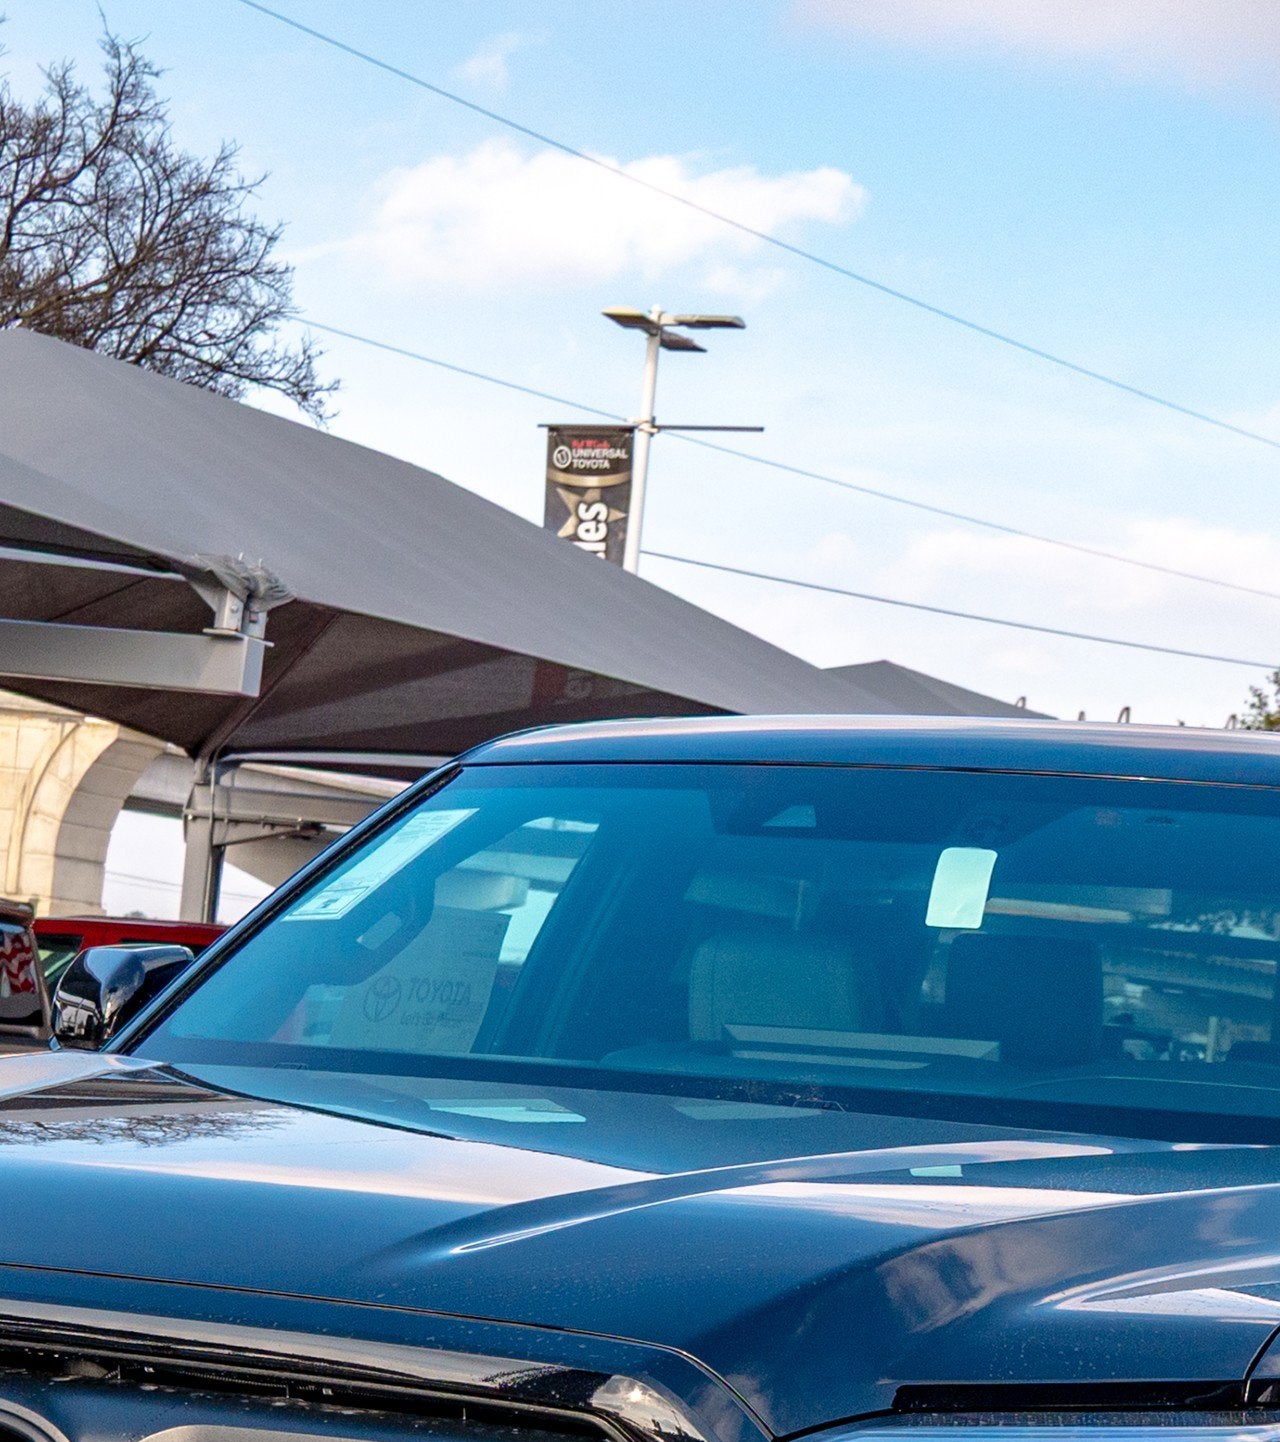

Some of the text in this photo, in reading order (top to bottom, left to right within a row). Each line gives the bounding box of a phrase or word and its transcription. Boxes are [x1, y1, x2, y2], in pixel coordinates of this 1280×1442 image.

[572, 448, 629, 459] UNIVERSAL
[572, 459, 610, 469] TOYOTA
[573, 502, 607, 558] les
[407, 976, 471, 1006] TOYOTA
